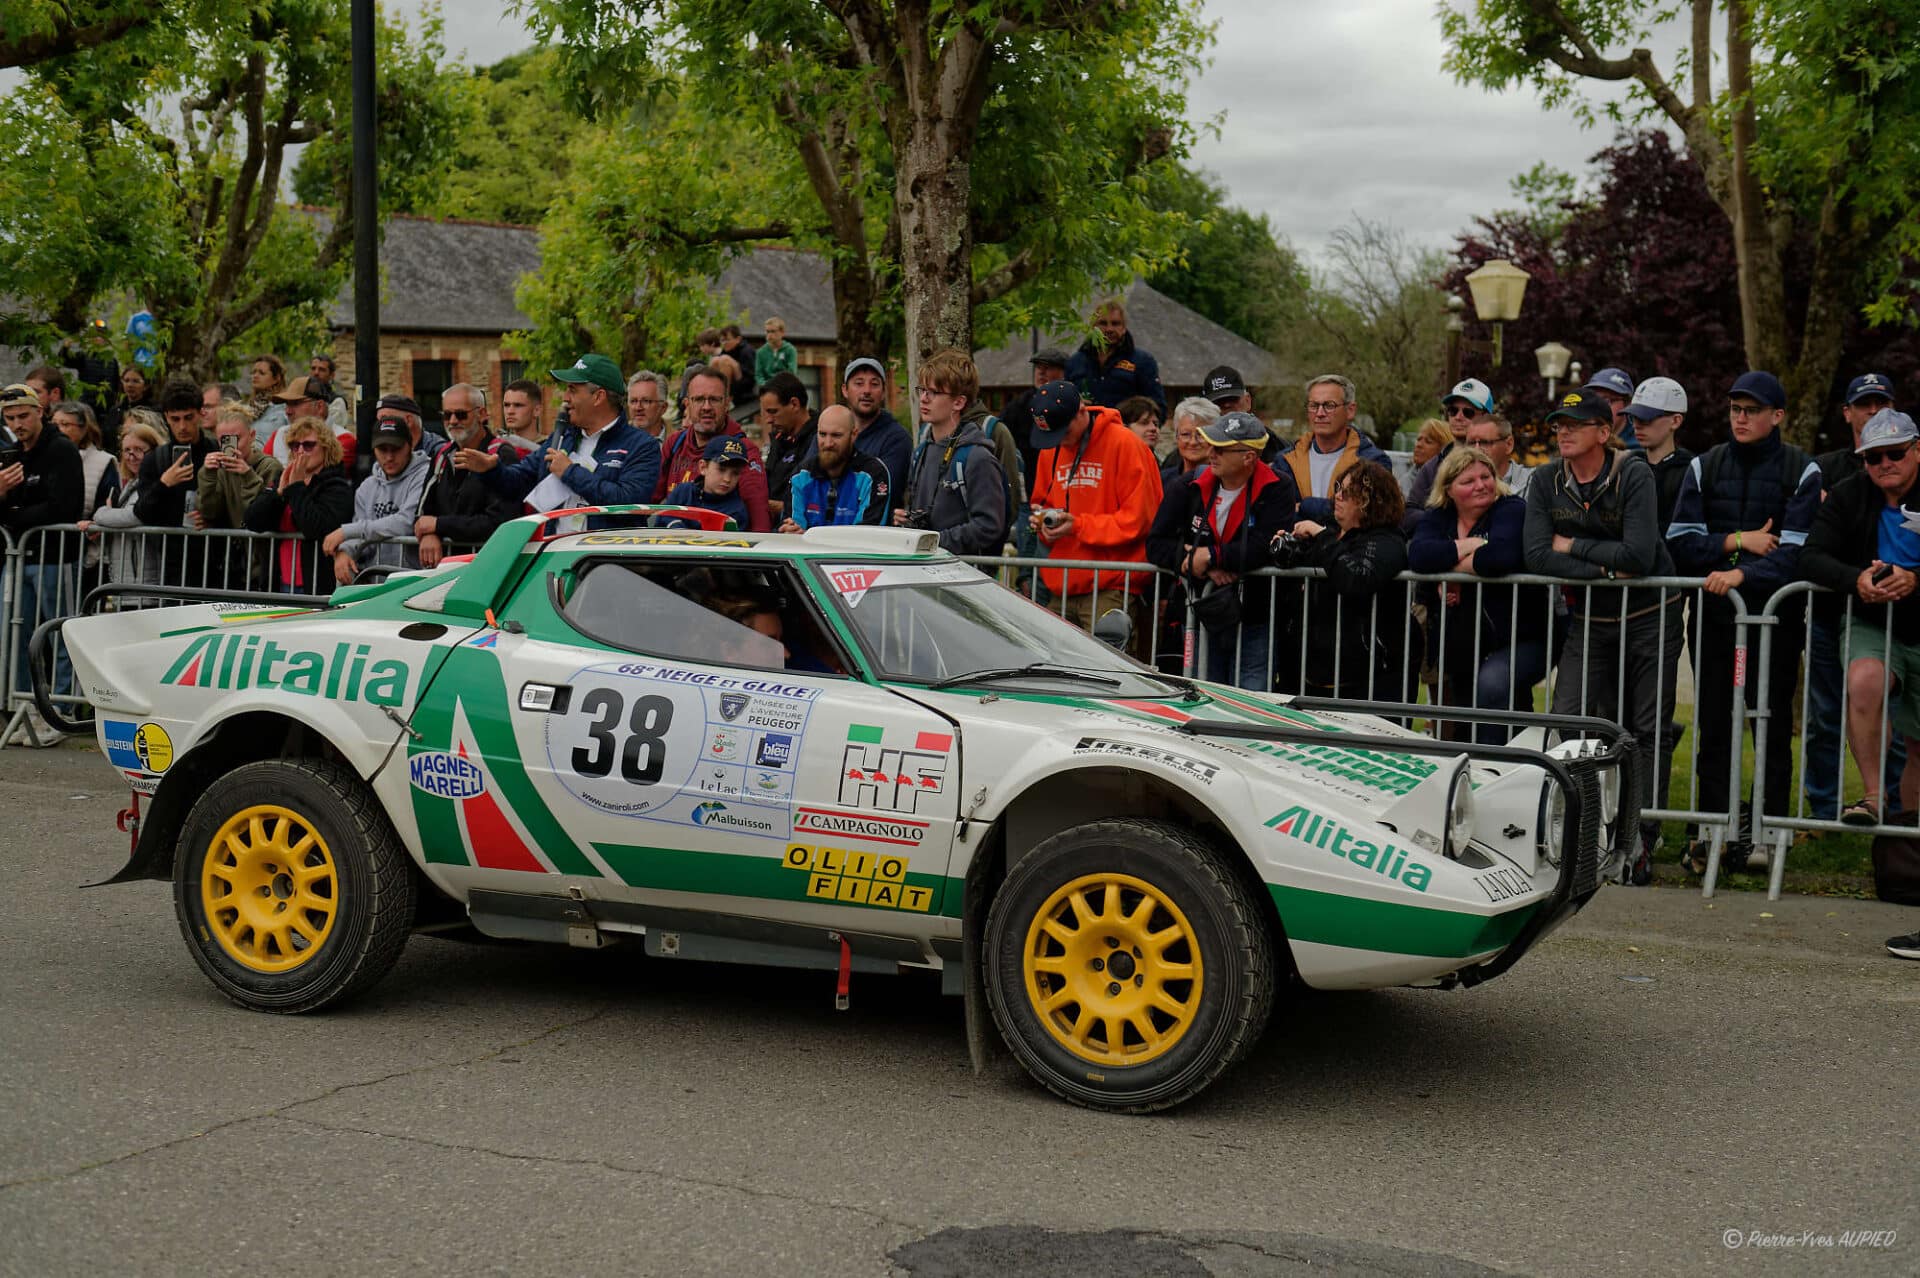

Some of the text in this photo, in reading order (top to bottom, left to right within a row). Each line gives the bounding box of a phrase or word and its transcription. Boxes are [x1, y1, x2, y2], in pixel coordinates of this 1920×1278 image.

[584, 535, 751, 548] OMEGA
[835, 573, 866, 590] 177
[160, 634, 409, 708] Alitalia
[655, 668, 720, 685] NEIGE
[719, 680, 738, 688] ET
[742, 681, 810, 698] GLACE
[571, 688, 674, 786] 38
[748, 716, 801, 731] PEUGEOT
[763, 743, 788, 757] bleu
[411, 754, 483, 783] MAGNETI
[411, 765, 483, 797] MARELLI
[837, 745, 948, 814] HF
[1120, 750, 1151, 760] RALLY
[1154, 758, 1213, 786] CHAMPION
[582, 791, 650, 811] www.zaniroli.com
[700, 780, 714, 791] Le
[717, 782, 738, 794] Lac
[705, 811, 772, 831] Malbuisson
[811, 815, 924, 841] CAMPAGNOLO
[789, 847, 902, 878] OLIO
[1263, 805, 1433, 893] Alitalia
[815, 878, 926, 907] FIAT
[1473, 867, 1533, 903] LANCIA
